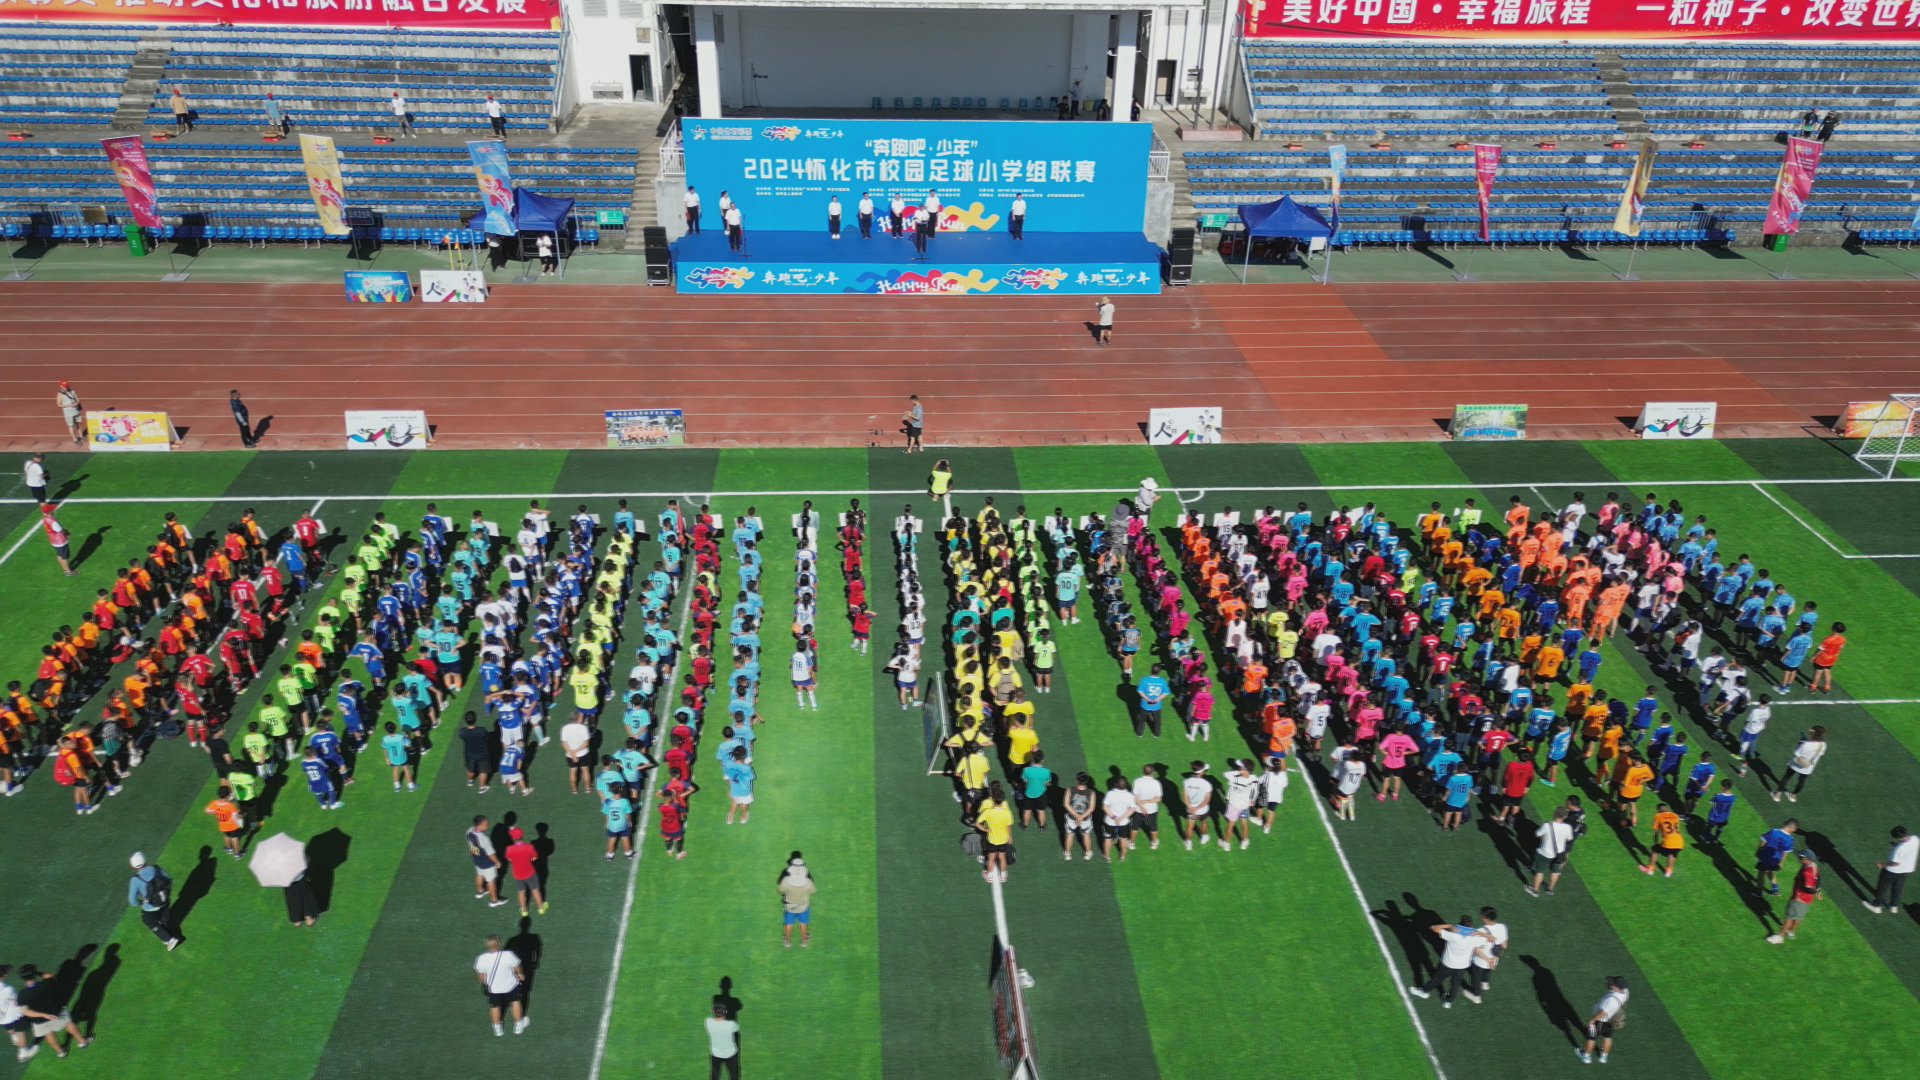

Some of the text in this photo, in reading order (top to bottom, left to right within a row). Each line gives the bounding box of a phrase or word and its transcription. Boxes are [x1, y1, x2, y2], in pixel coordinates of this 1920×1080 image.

[865, 138, 978, 157] “奔跑吧·少年”
[744, 158, 1096, 183] 2024怀化市校园足球小学组联赛
[876, 277, 965, 294] Happy Run
[303, 526, 308, 536] 9
[1061, 580, 1072, 590] 10
[386, 605, 391, 614] 1
[444, 606, 450, 615] 3
[440, 642, 451, 652] 10
[1548, 659, 1554, 667] 6
[485, 670, 491, 680] 1
[578, 685, 589, 694] 12
[1147, 686, 1162, 696] 50
[633, 720, 640, 729] 3
[1317, 716, 1324, 726] 5
[1395, 747, 1402, 757] 5
[501, 753, 516, 766] 21
[611, 811, 620, 821] 5
